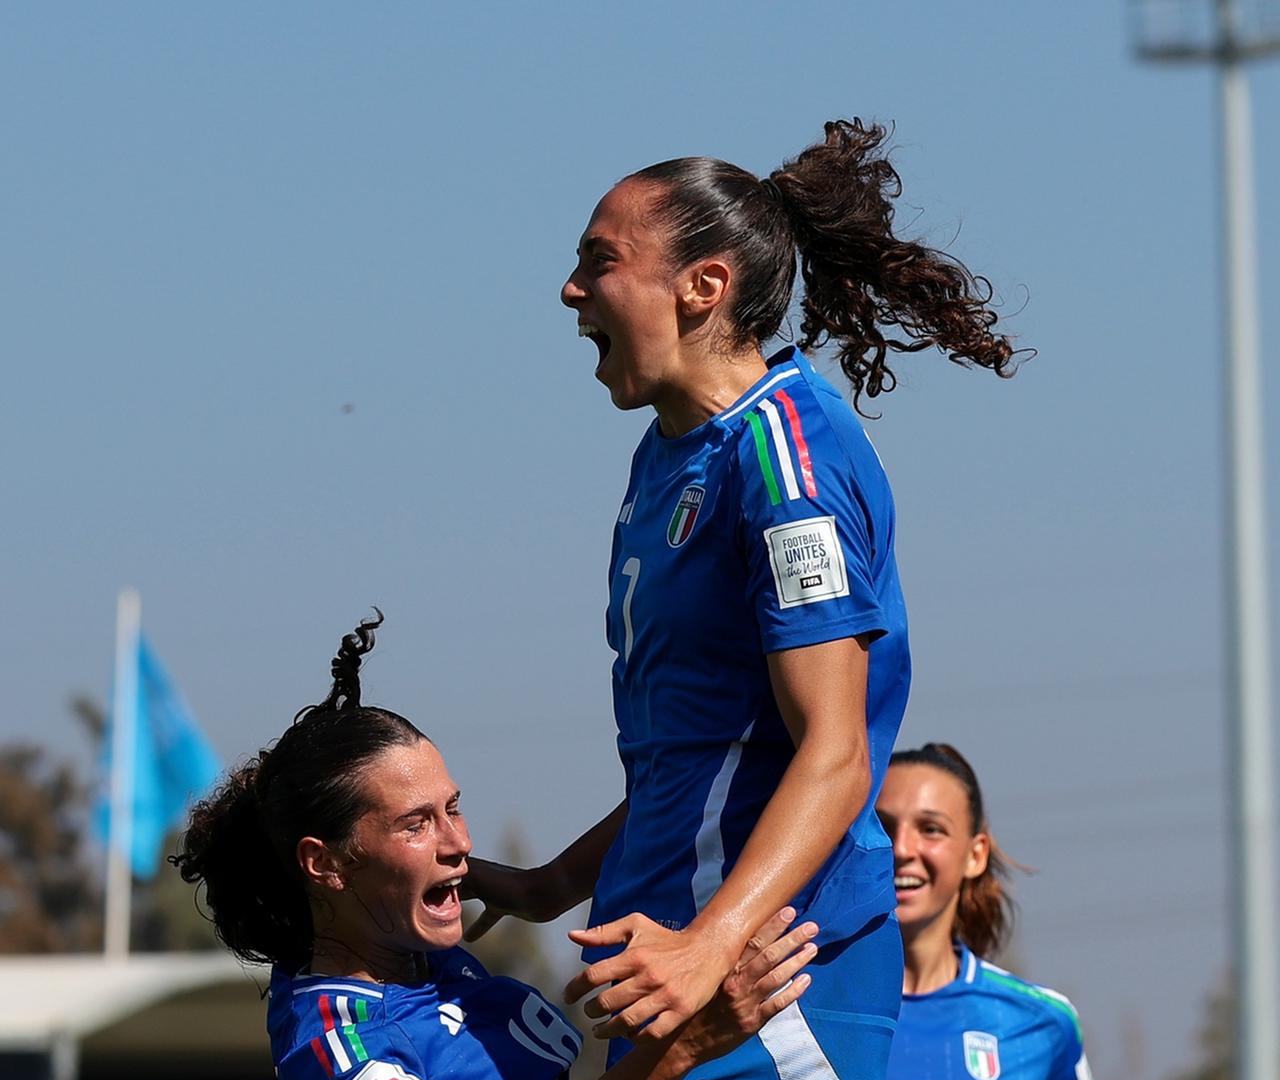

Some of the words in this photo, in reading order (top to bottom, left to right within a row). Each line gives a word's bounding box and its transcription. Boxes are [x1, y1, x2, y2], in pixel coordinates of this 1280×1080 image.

[782, 532, 824, 549] FOOTBALL
[784, 543, 827, 564] UNITES
[786, 564, 802, 578] the
[802, 557, 831, 574] World
[802, 577, 821, 587] FIFA
[621, 556, 641, 665] 7
